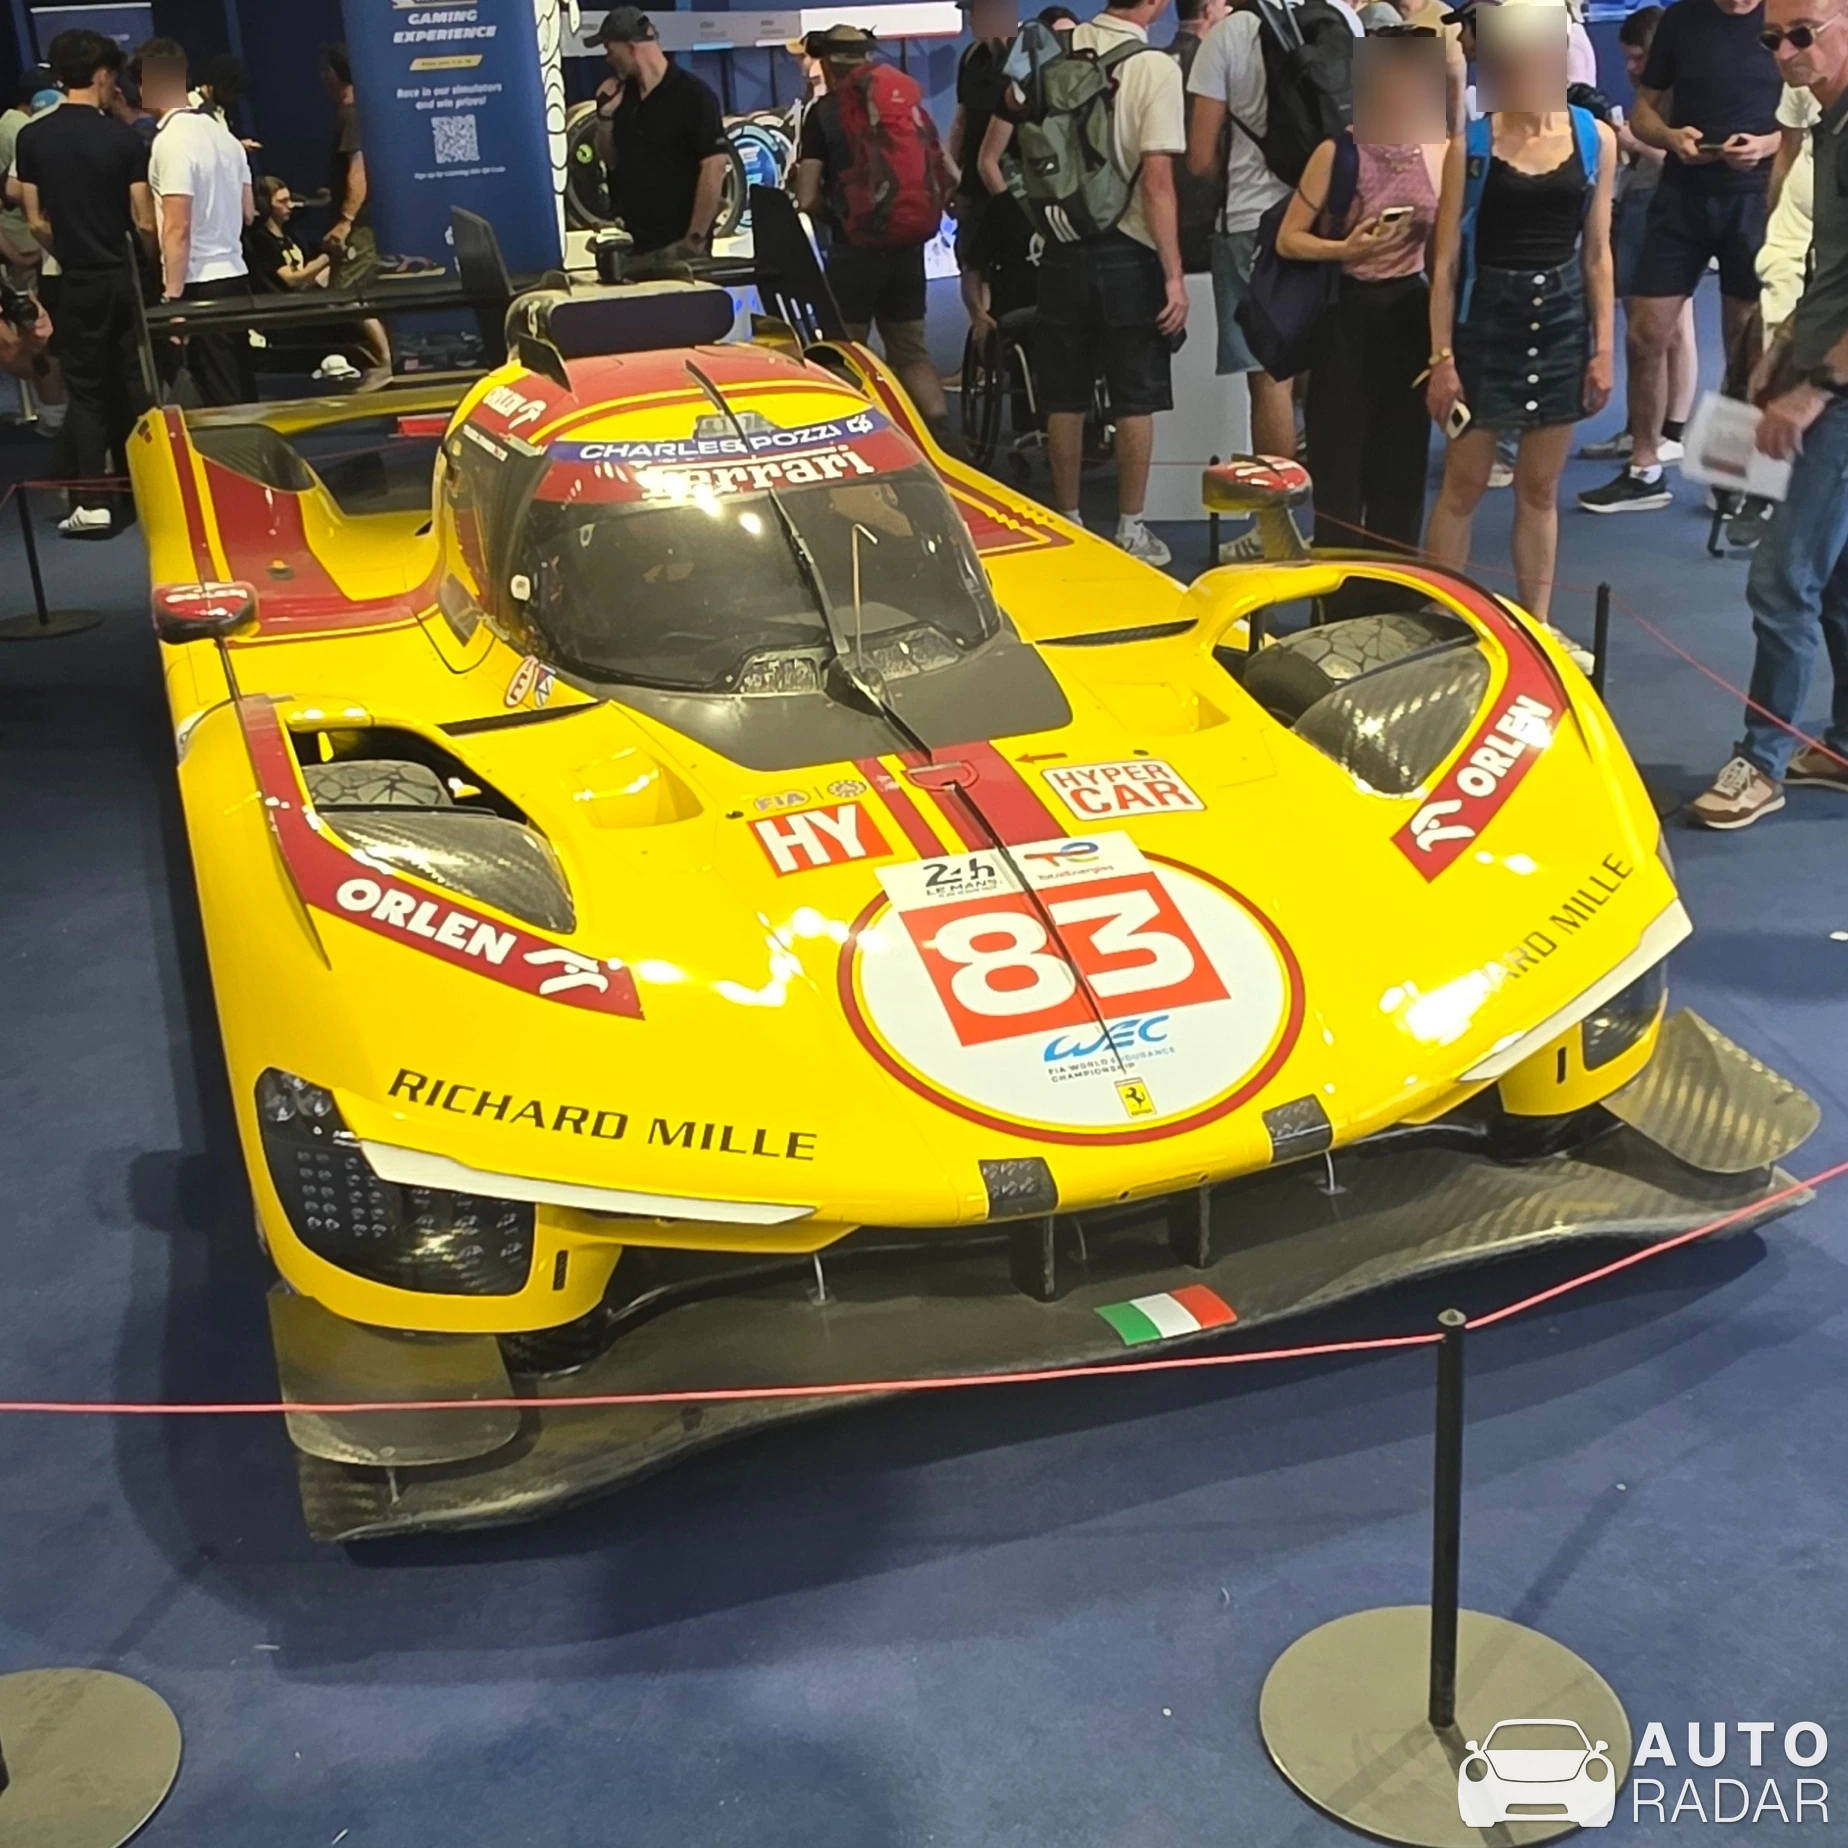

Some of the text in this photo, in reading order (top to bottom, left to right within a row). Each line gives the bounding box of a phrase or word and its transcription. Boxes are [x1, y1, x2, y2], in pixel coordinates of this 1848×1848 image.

[393, 25, 497, 43] EXPERIENCE
[408, 9, 478, 25] GAMING
[580, 438, 749, 460] CHARLES
[632, 445, 875, 504] Ferrari
[1456, 694, 1553, 798] ORLEN
[1052, 764, 1171, 789] HYPER
[1069, 780, 1194, 814] CAR
[756, 792, 805, 811] FIA
[755, 804, 867, 873] HY
[336, 879, 517, 965] ORLEN
[940, 888, 1195, 1017] 83
[1043, 1015, 1170, 1062] WEC
[387, 1067, 818, 1161] RICHARD MILLE
